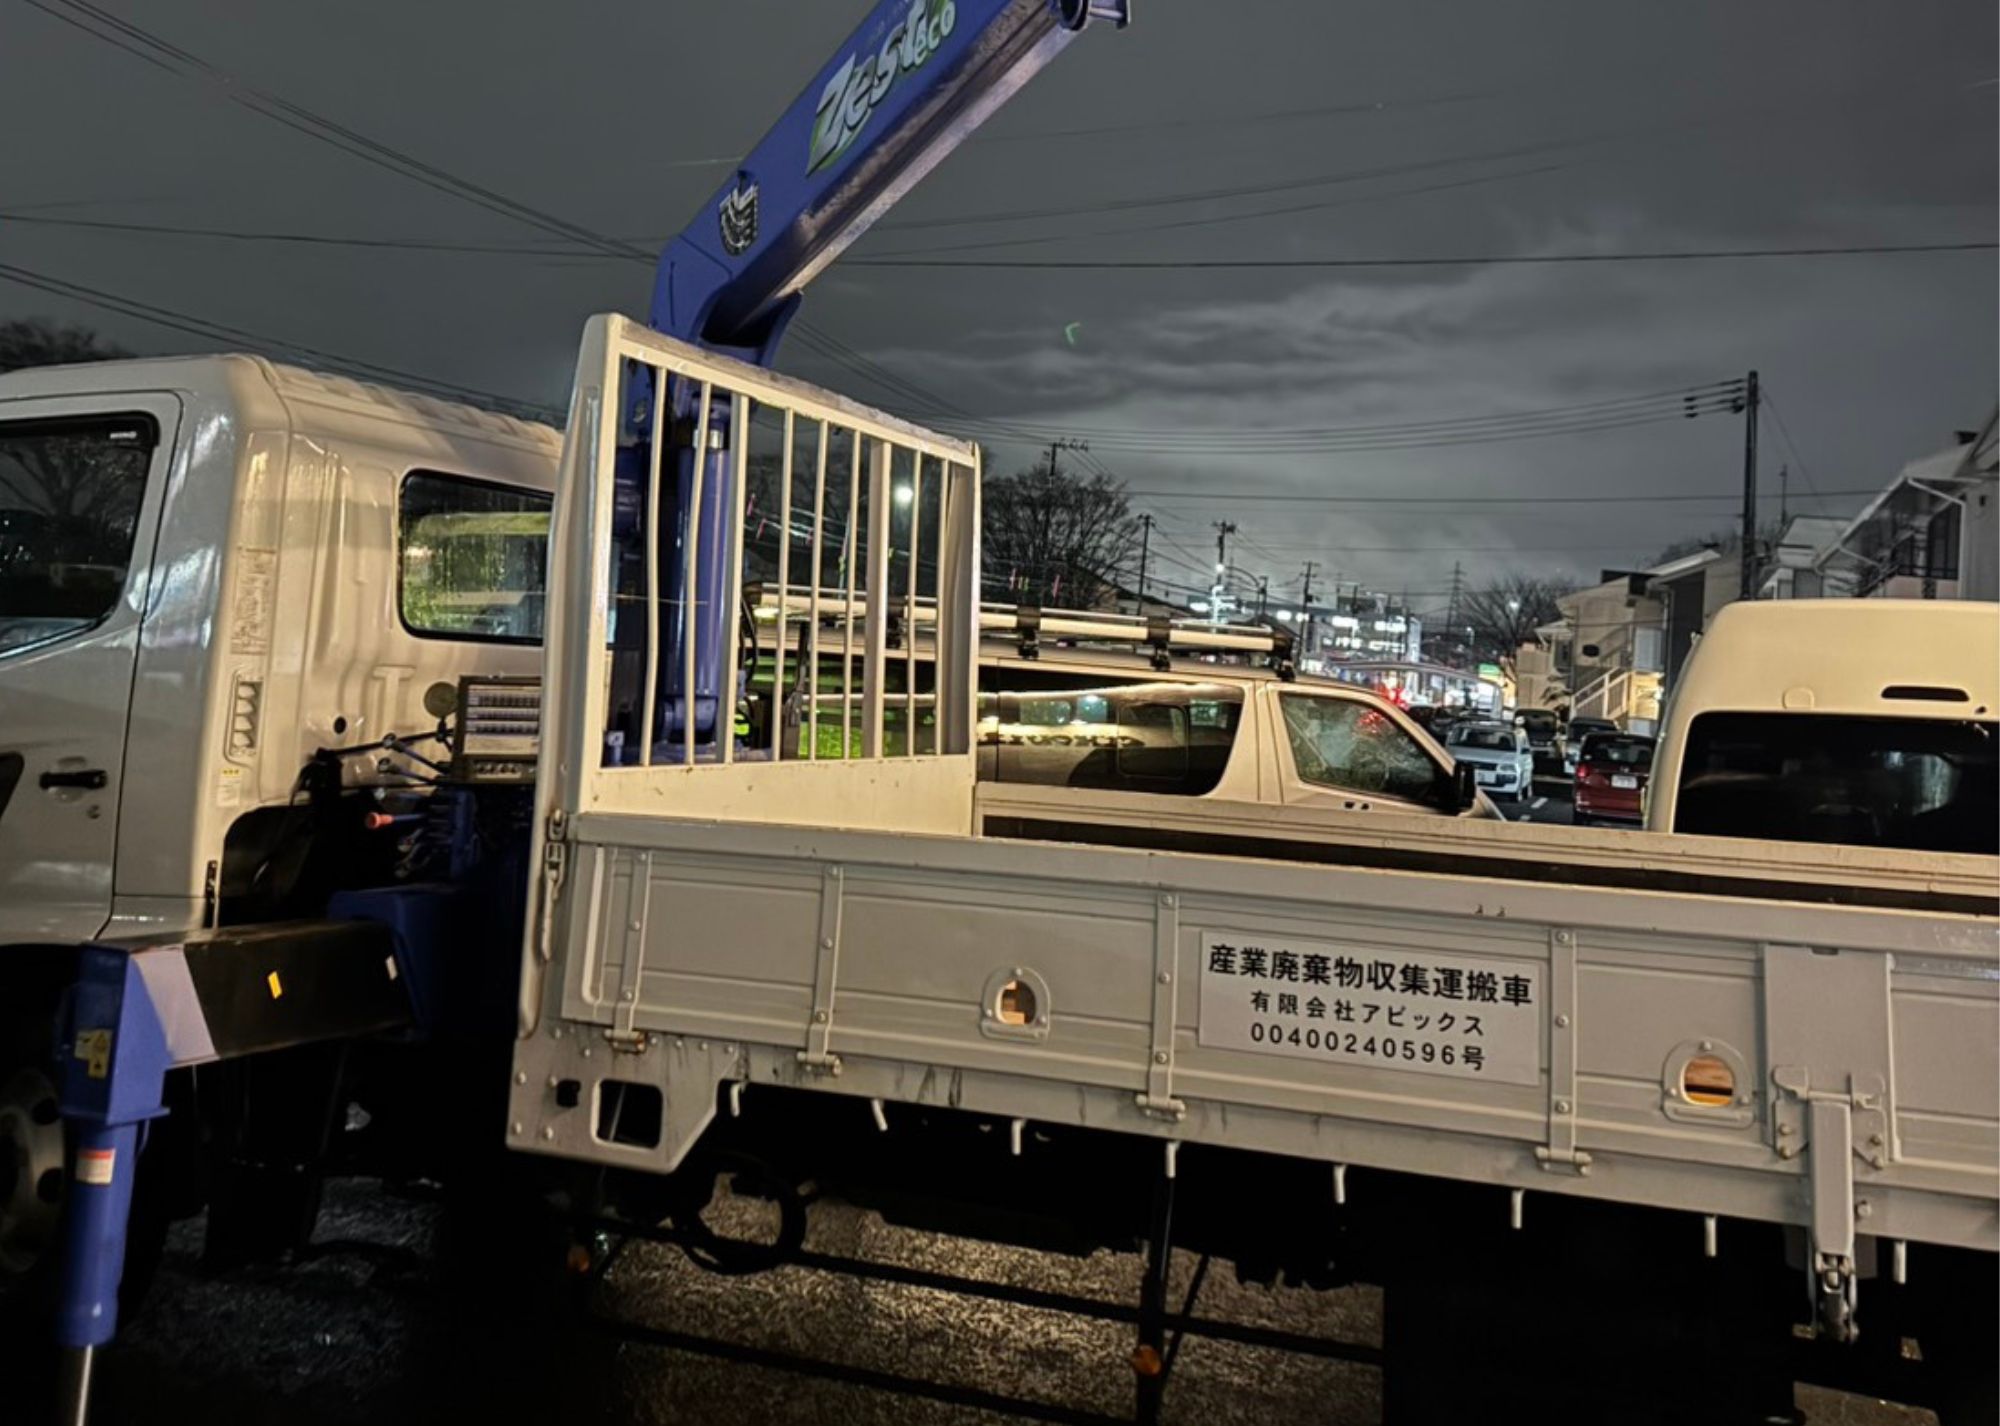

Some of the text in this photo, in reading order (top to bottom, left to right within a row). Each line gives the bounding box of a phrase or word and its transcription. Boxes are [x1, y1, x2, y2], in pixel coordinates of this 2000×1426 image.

[1208, 944, 1533, 1007] 産業廃棄物収集運搬車
[1251, 1023, 1486, 1071] 00400240596号
